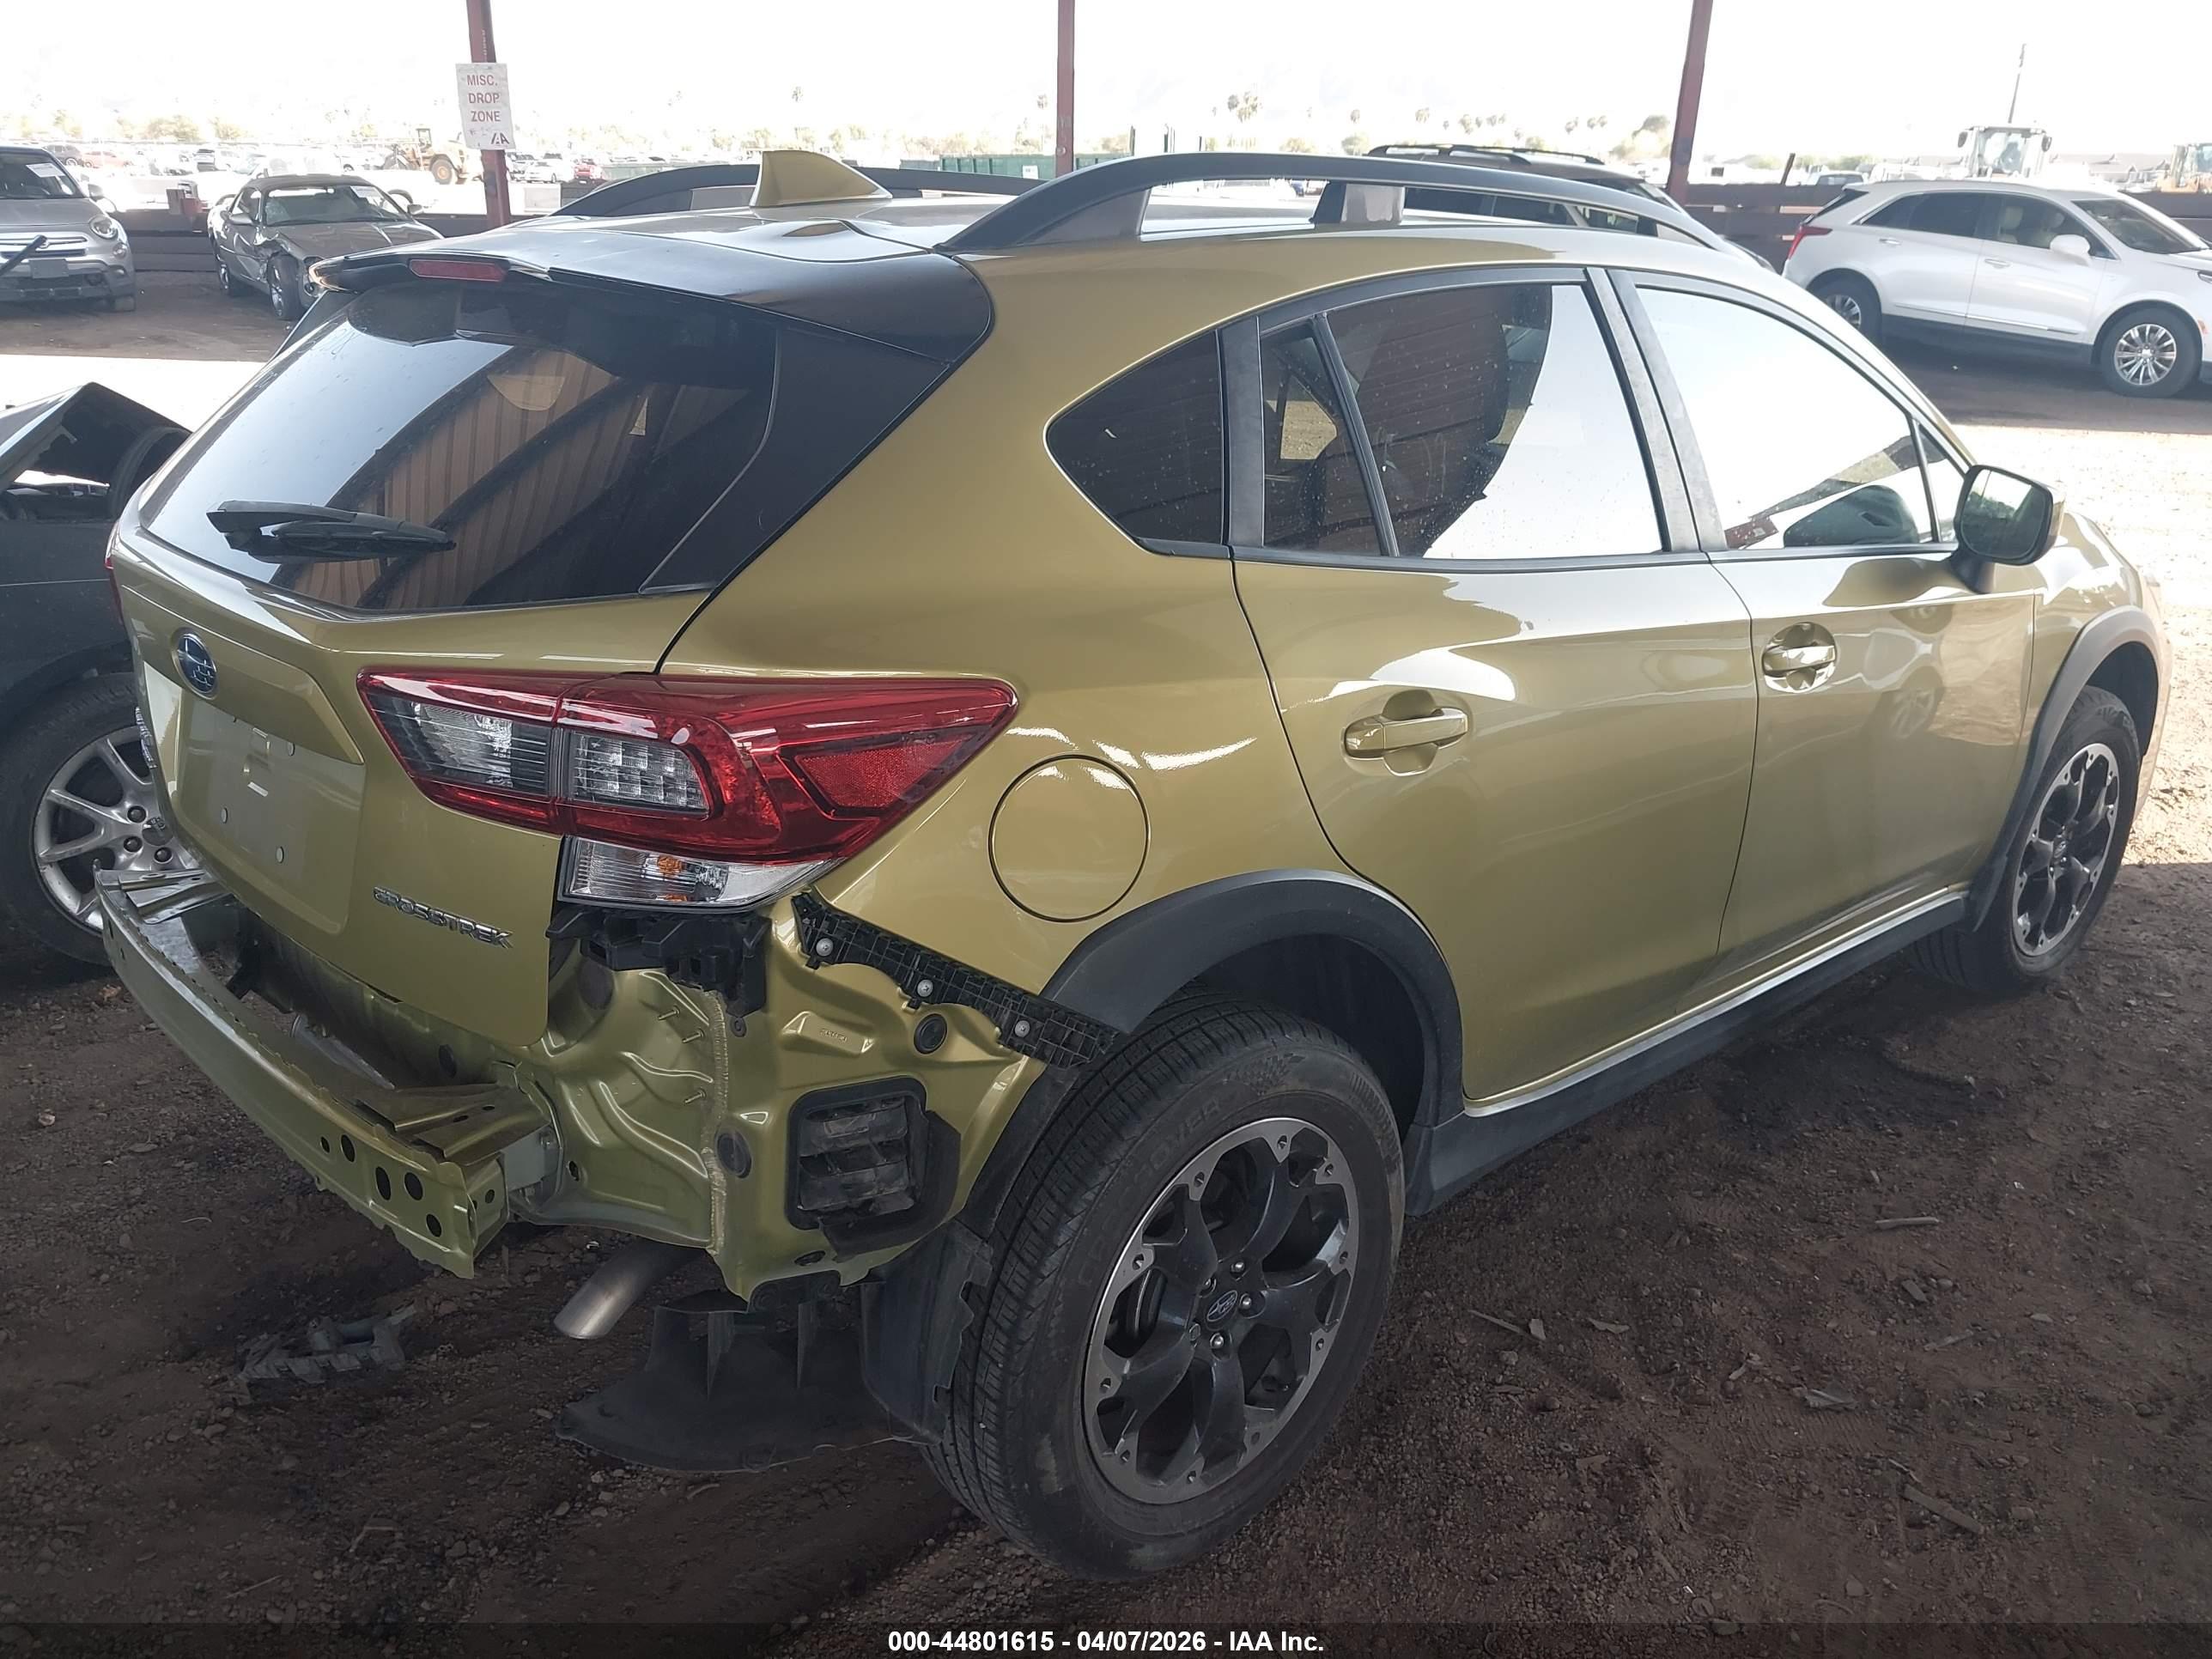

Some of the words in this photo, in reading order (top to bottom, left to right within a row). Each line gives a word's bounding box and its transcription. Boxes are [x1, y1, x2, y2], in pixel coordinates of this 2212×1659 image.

[466, 74, 498, 87] MISC.
[468, 92, 500, 104] DROP
[471, 110, 501, 122] ZONE
[373, 886, 514, 950] CROSSTREK
